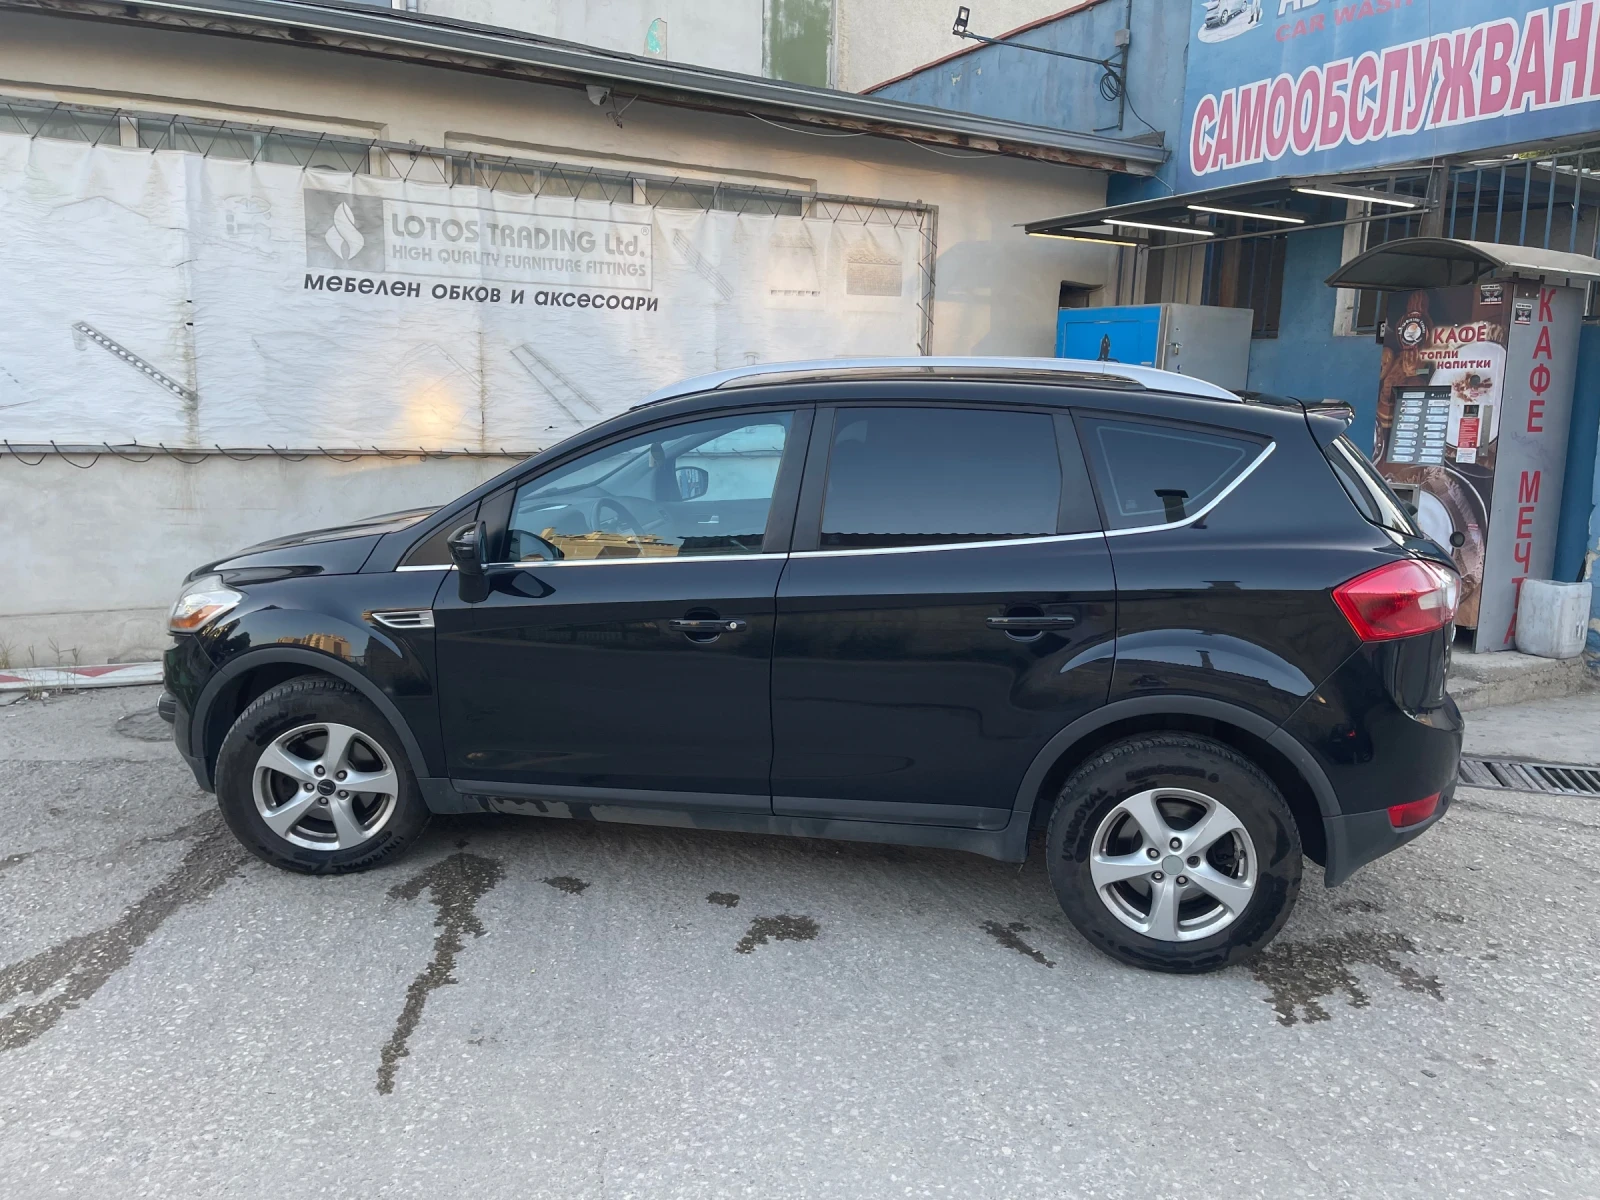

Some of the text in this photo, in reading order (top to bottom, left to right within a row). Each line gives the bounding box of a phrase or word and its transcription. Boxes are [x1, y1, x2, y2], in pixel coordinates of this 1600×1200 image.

[1275, 13, 1325, 43] CAR
[391, 213, 646, 258] LOTOS TRADING Ltd.
[392, 244, 647, 277] HIGH QUALITY FURNITURE FITTINGS
[431, 283, 502, 303] обков
[510, 289, 525, 305] и
[534, 290, 659, 312] аксесоари
[1433, 324, 1488, 344] КАФЕ
[1526, 287, 1557, 433] КАФЕ
